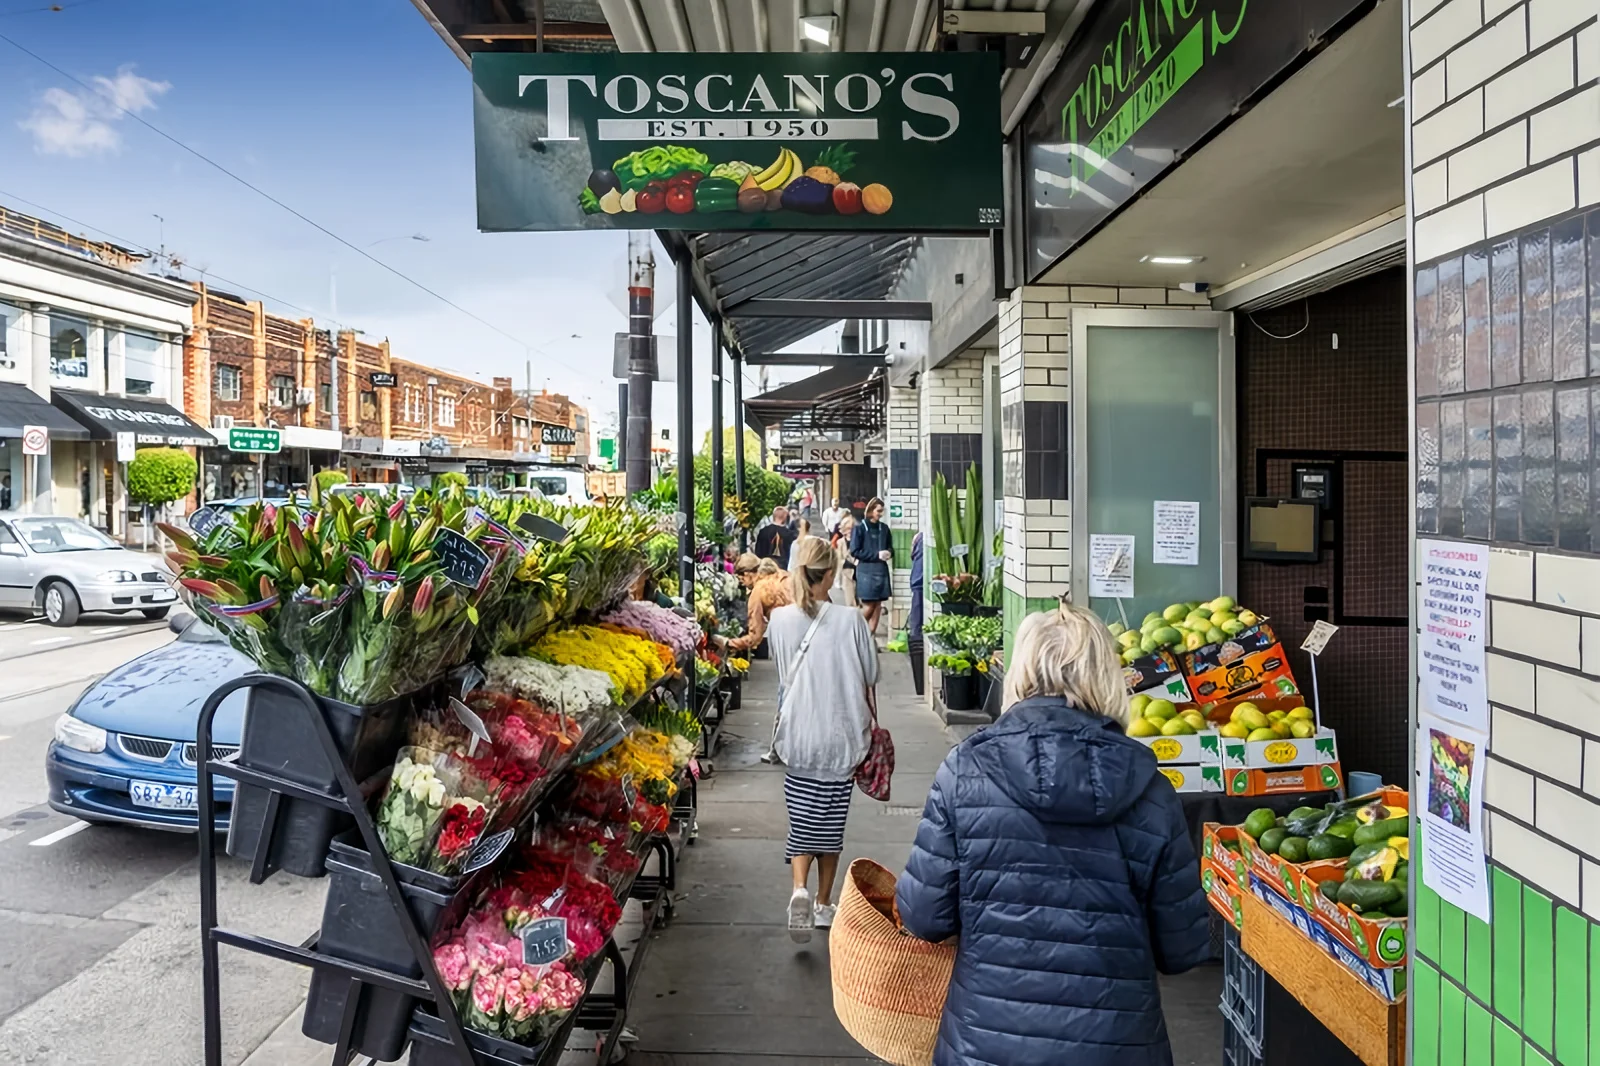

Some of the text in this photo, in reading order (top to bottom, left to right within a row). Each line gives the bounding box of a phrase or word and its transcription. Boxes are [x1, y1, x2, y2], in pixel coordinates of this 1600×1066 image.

[518, 67, 960, 142] TOSCANO'S
[1135, 55, 1176, 124] 1950
[647, 120, 829, 138] EST. 1950
[810, 443, 856, 462] seed
